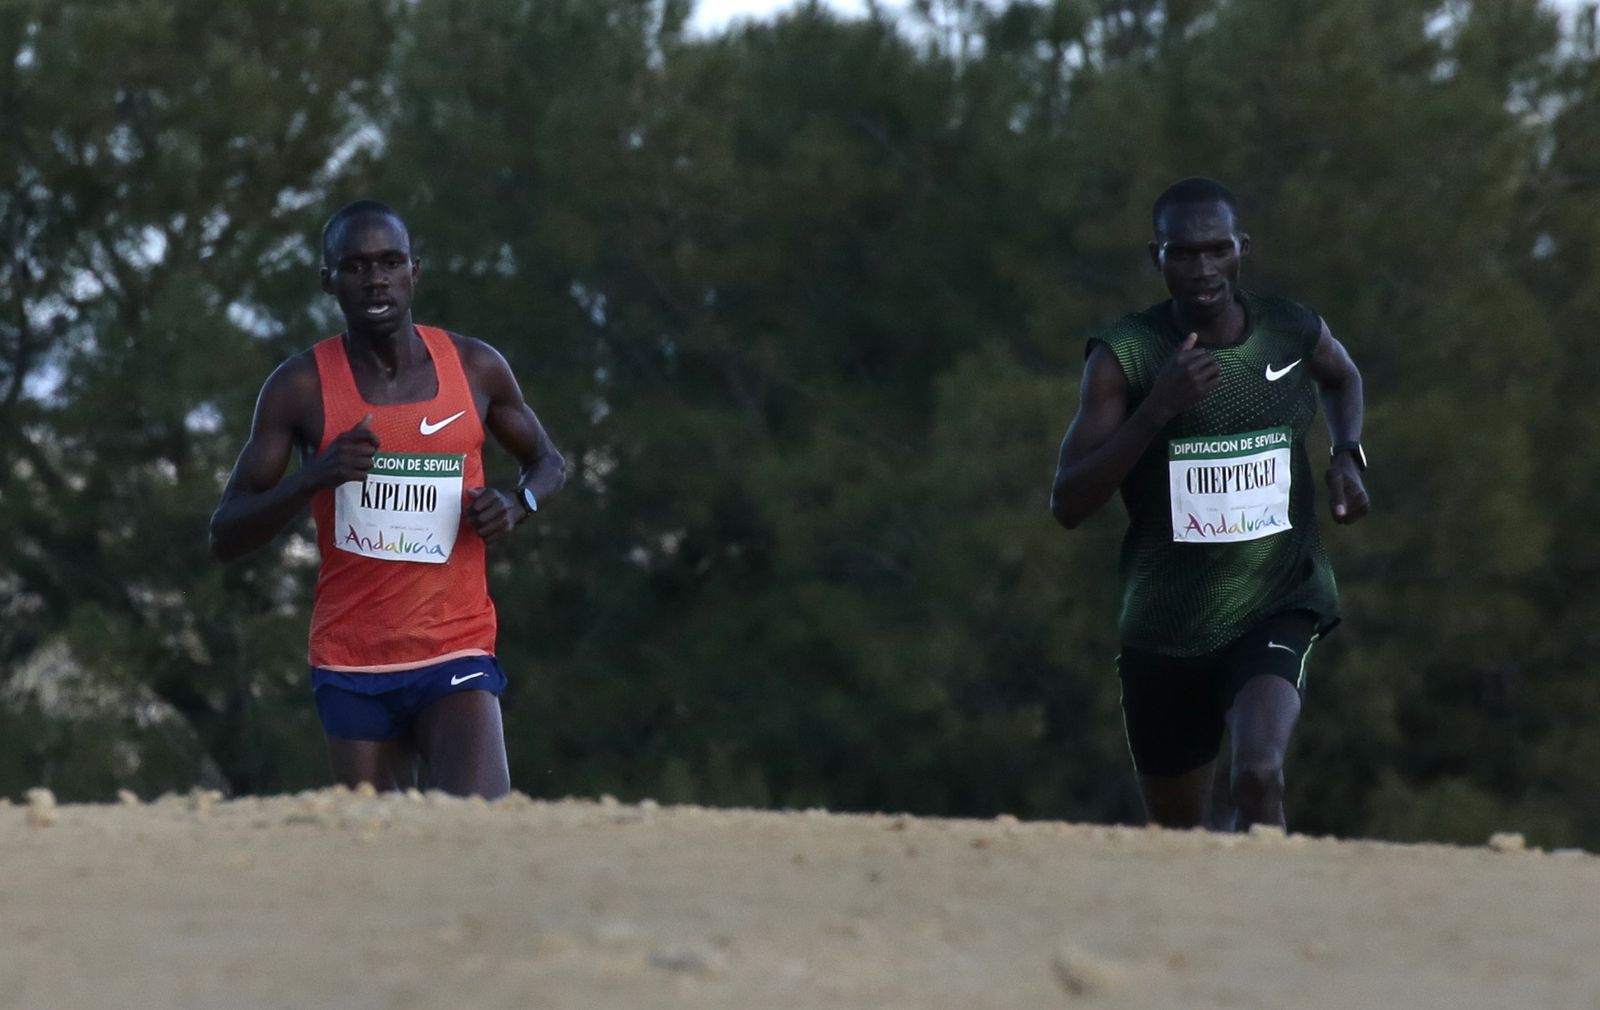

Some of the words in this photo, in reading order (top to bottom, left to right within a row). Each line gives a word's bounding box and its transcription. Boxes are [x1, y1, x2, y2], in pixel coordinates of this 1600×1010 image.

[1174, 440, 1238, 455] DIPUTACION
[1240, 438, 1253, 451] DE
[1255, 433, 1287, 448] SEVILLA
[407, 459, 421, 471] DE
[423, 459, 460, 471] SEVILLA
[1186, 457, 1276, 495] CHEPTEGEI
[360, 481, 437, 512] KIPLIMO
[345, 524, 446, 557] Andalucía
